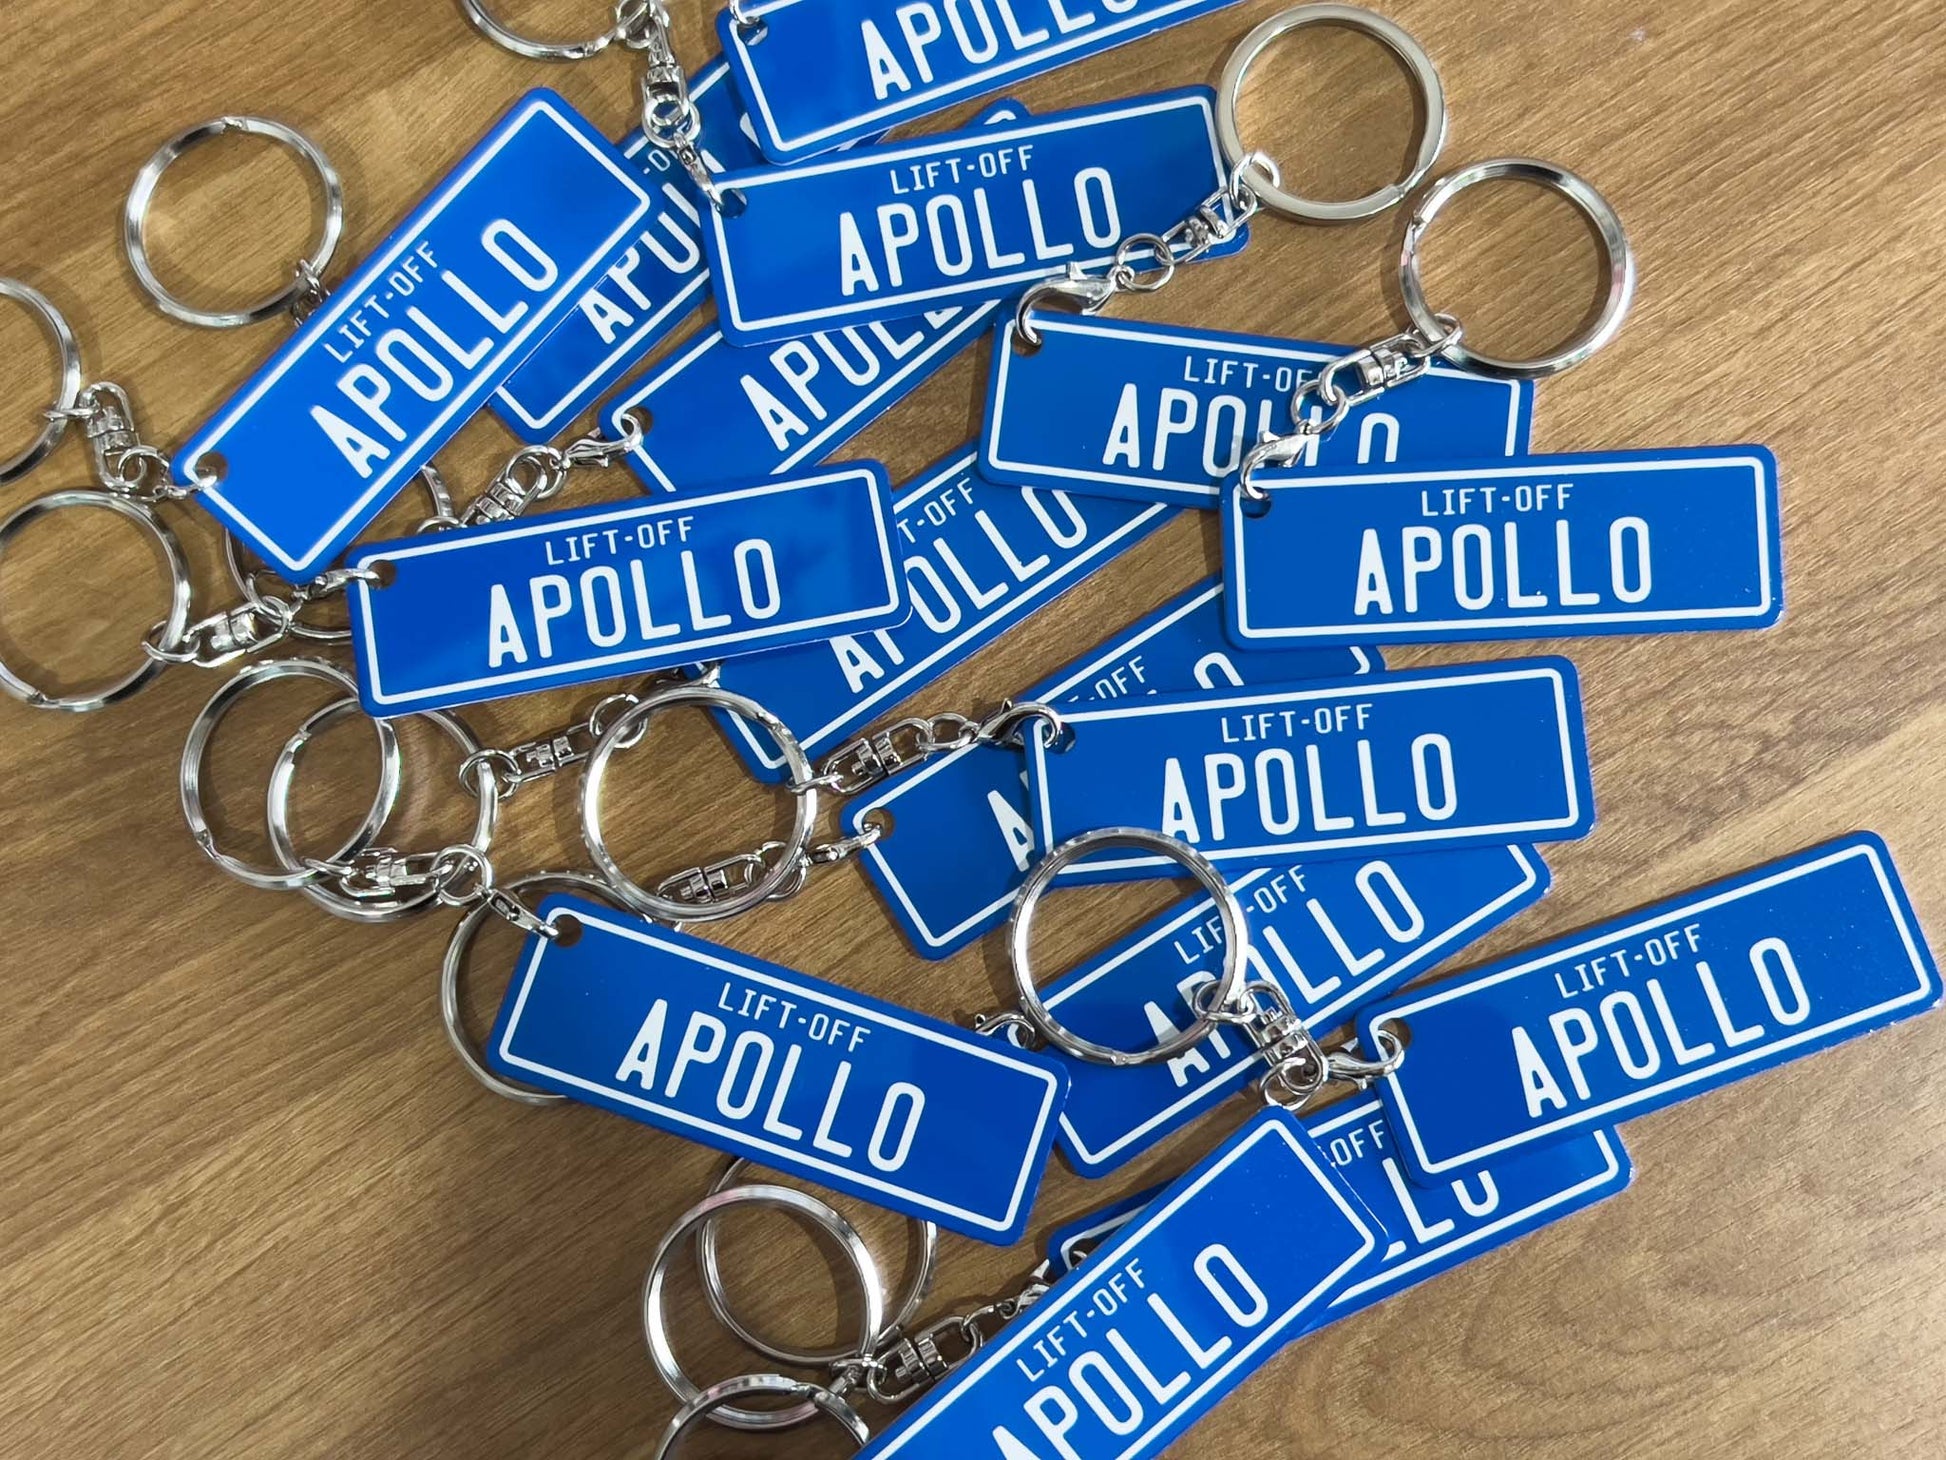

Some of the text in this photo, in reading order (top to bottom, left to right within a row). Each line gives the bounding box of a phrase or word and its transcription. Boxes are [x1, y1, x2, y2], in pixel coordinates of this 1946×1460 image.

[861, 0, 1138, 100] APOL
[891, 145, 1032, 193] LIFT-OFF
[840, 168, 1120, 295] APOLLO
[311, 219, 557, 478] APOLLO
[325, 242, 437, 362] LIFT-OFF
[740, 306, 963, 451] APOL
[1184, 355, 1314, 393] LIFT-OF
[546, 517, 693, 564] LIFT-OFF
[898, 477, 973, 543] T-OFF
[1422, 484, 1573, 516] LIFT-OFF
[489, 539, 780, 667] APOLLO
[1355, 517, 1651, 615] APOLLO
[1222, 704, 1371, 742] LIFT-OFF
[1162, 734, 1456, 843] APOLLO
[1174, 865, 1308, 965] LIF-OFF
[1555, 924, 1699, 997] LIFT-OFF
[719, 983, 870, 1051] LIFT-OFF
[1512, 938, 1810, 1117] APOLLO
[616, 999, 925, 1171] APOLLO
[1017, 1259, 1144, 1381] LIFT-OFF
